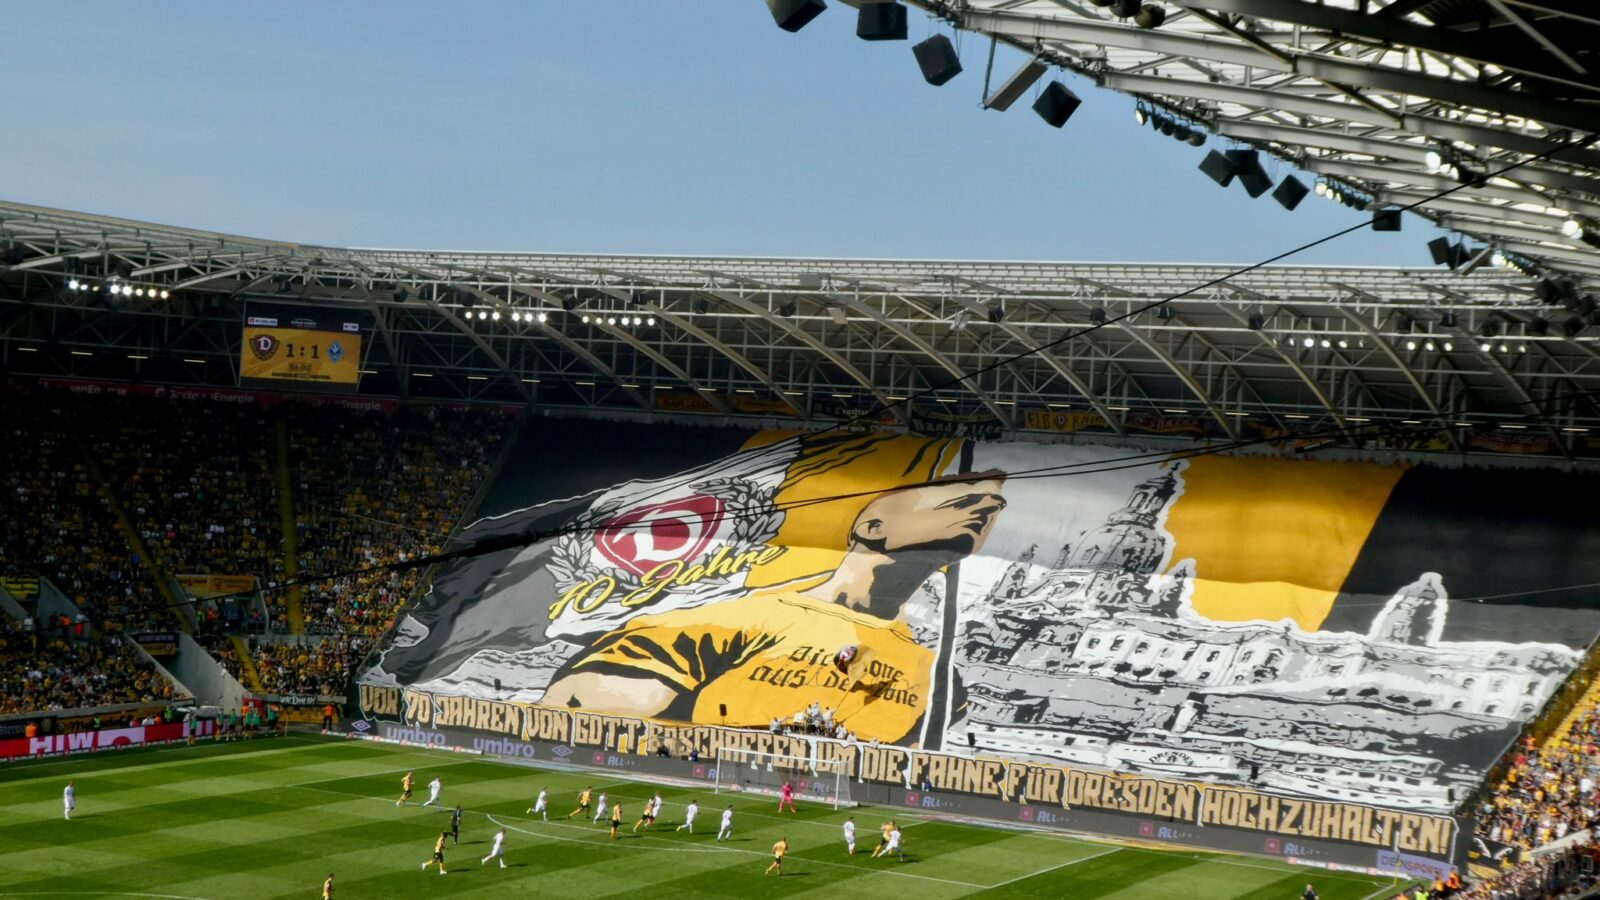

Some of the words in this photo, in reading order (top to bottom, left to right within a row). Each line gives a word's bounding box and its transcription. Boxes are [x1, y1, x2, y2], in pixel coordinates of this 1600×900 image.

[620, 545, 788, 607] Jahre
[748, 665, 808, 689] aus
[862, 660, 904, 682] one
[386, 724, 447, 745] umbro
[473, 737, 535, 758] umbro
[361, 685, 400, 715] VOR
[407, 690, 430, 723] 70
[435, 696, 519, 735] JAHREN
[526, 707, 568, 742] VON
[575, 712, 642, 750] GOTT
[816, 742, 857, 776] UM
[862, 747, 904, 783] DIE
[911, 752, 1001, 795] FAHNE
[1007, 763, 1062, 803] FÜR
[1068, 769, 1196, 822] DRESDEN
[1202, 788, 1452, 855] HOCHZUHALTEN!
